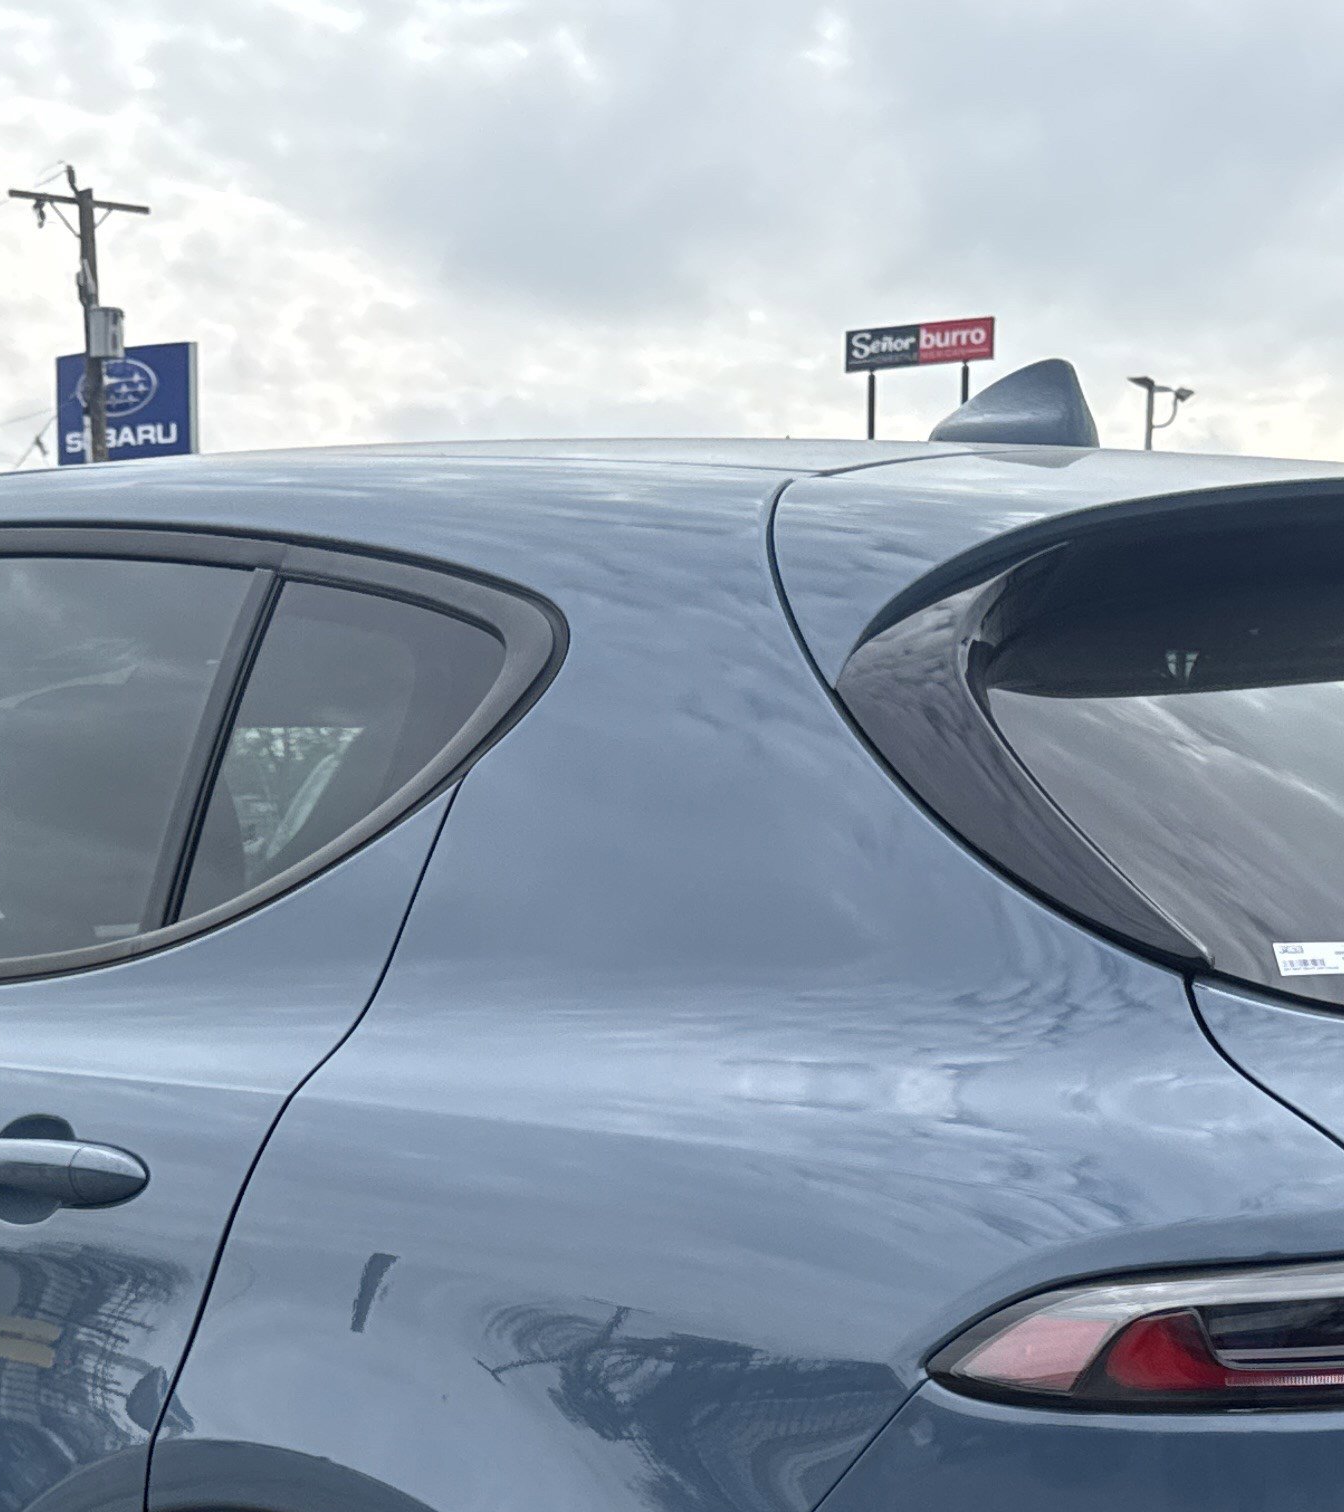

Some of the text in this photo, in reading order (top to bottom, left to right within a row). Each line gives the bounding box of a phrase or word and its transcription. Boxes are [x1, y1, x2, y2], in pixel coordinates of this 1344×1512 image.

[851, 332, 916, 359] Señor
[919, 327, 987, 350] burro
[65, 422, 177, 453] SBARU
